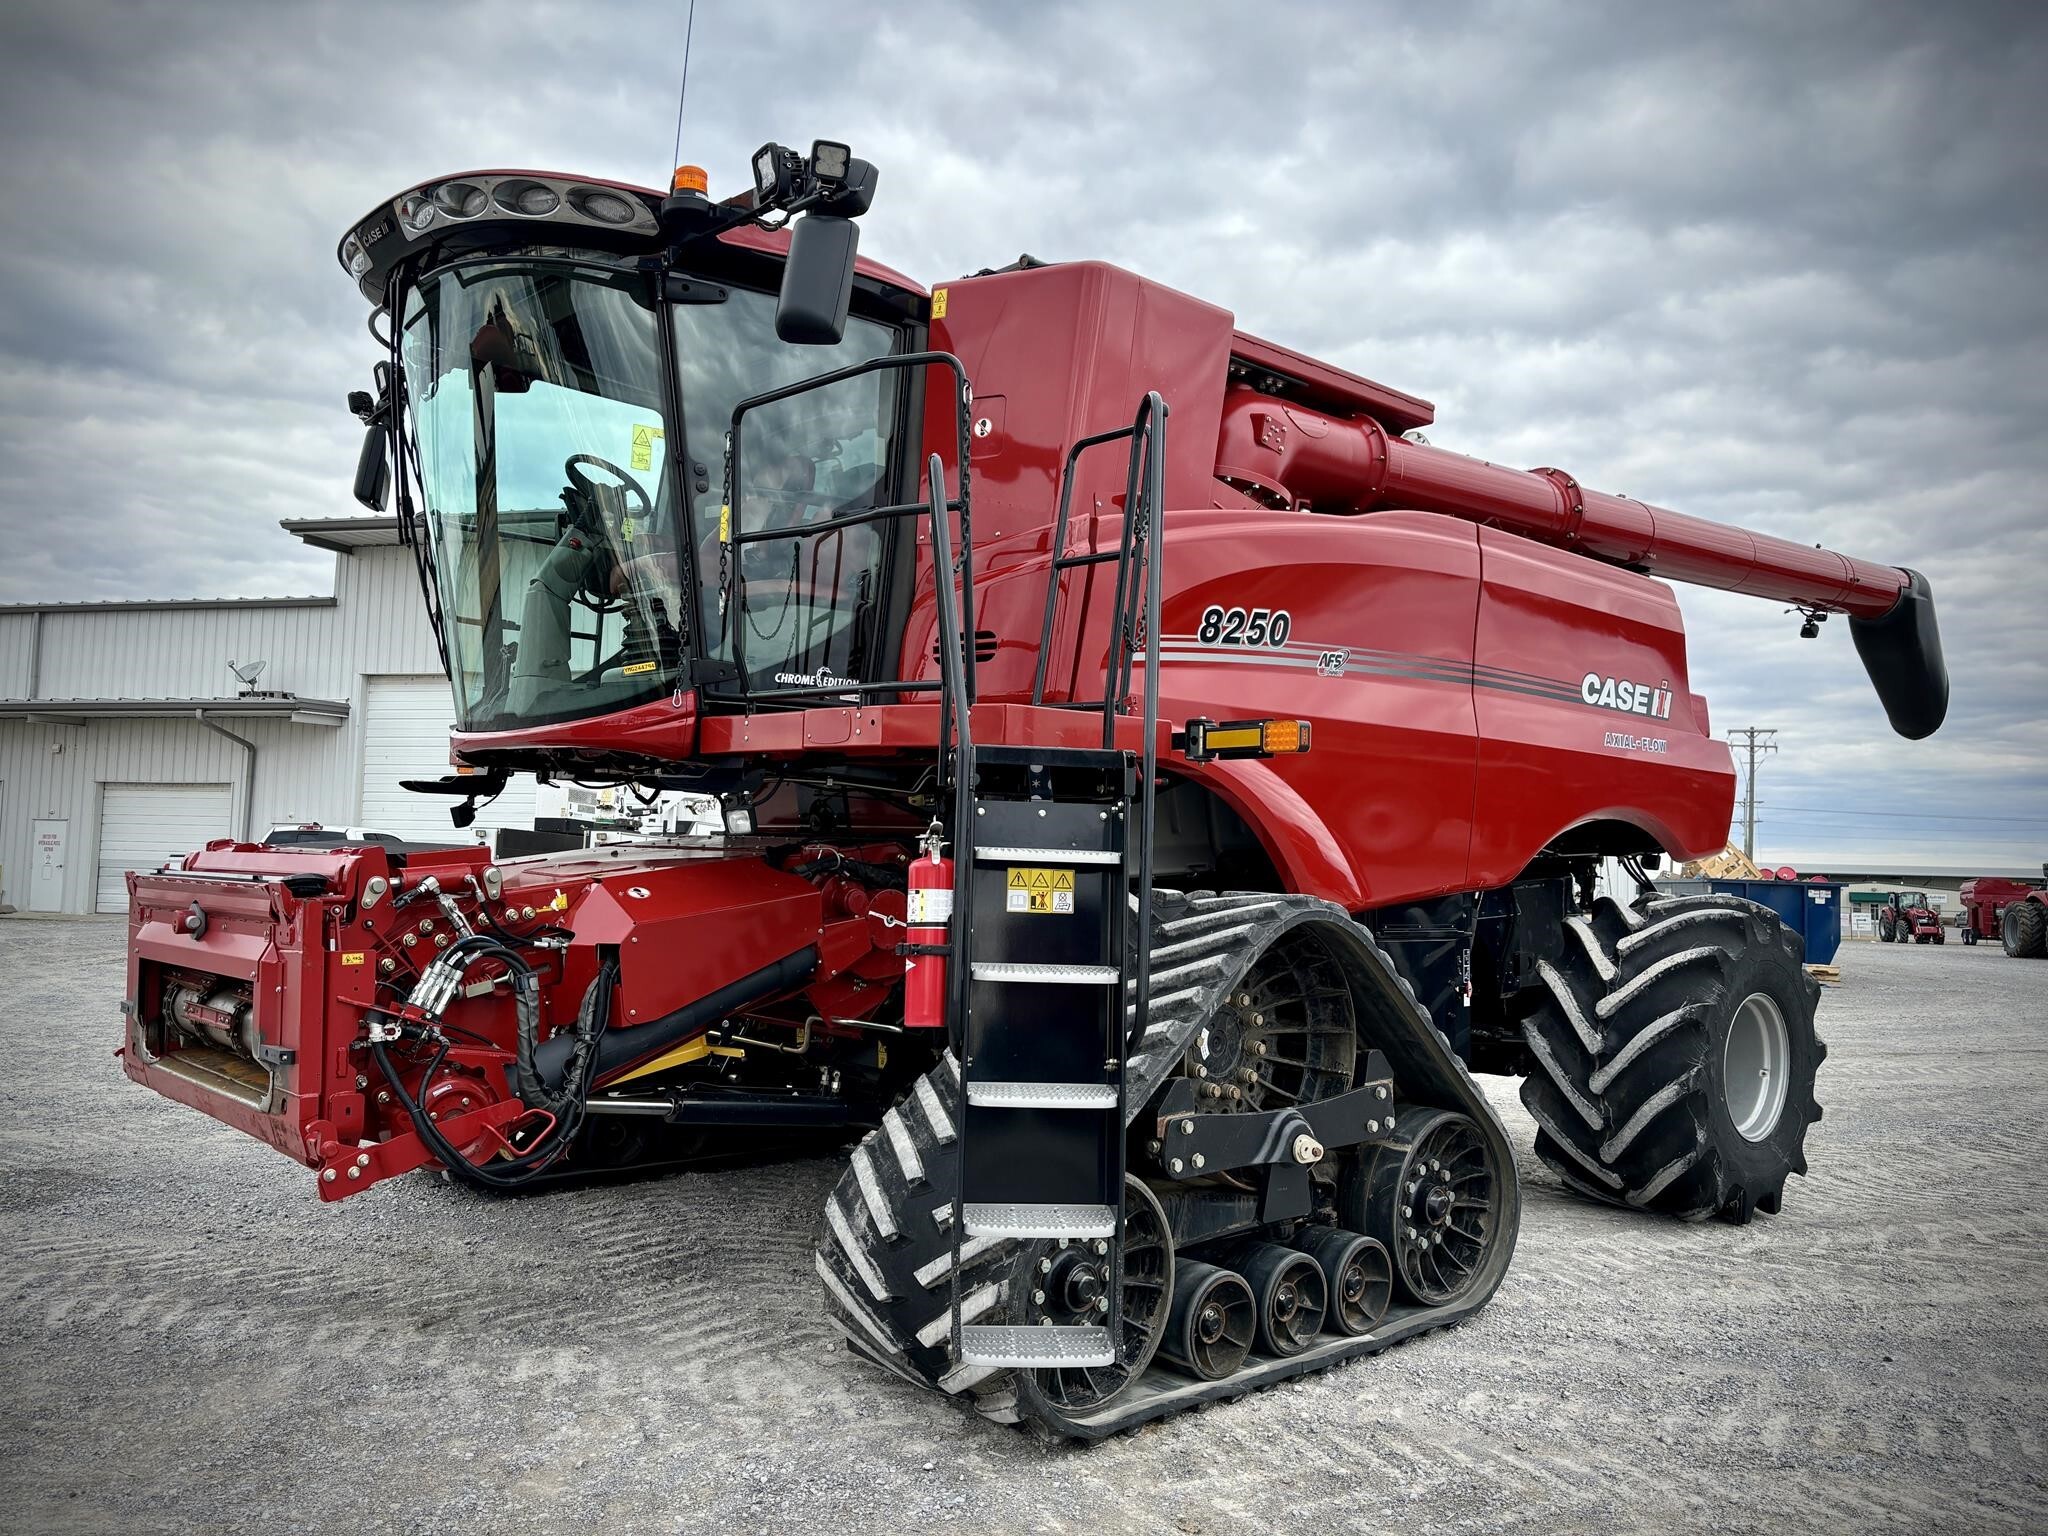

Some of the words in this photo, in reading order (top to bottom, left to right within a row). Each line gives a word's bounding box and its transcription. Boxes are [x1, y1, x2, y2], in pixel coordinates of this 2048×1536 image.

[362, 227, 382, 247] CASE
[1198, 605, 1291, 649] 8250
[1317, 651, 1343, 668] AFS
[774, 673, 816, 686] CHROME
[1581, 673, 1650, 714] CASE
[1604, 732, 1667, 754] AXIAL-FLOW
